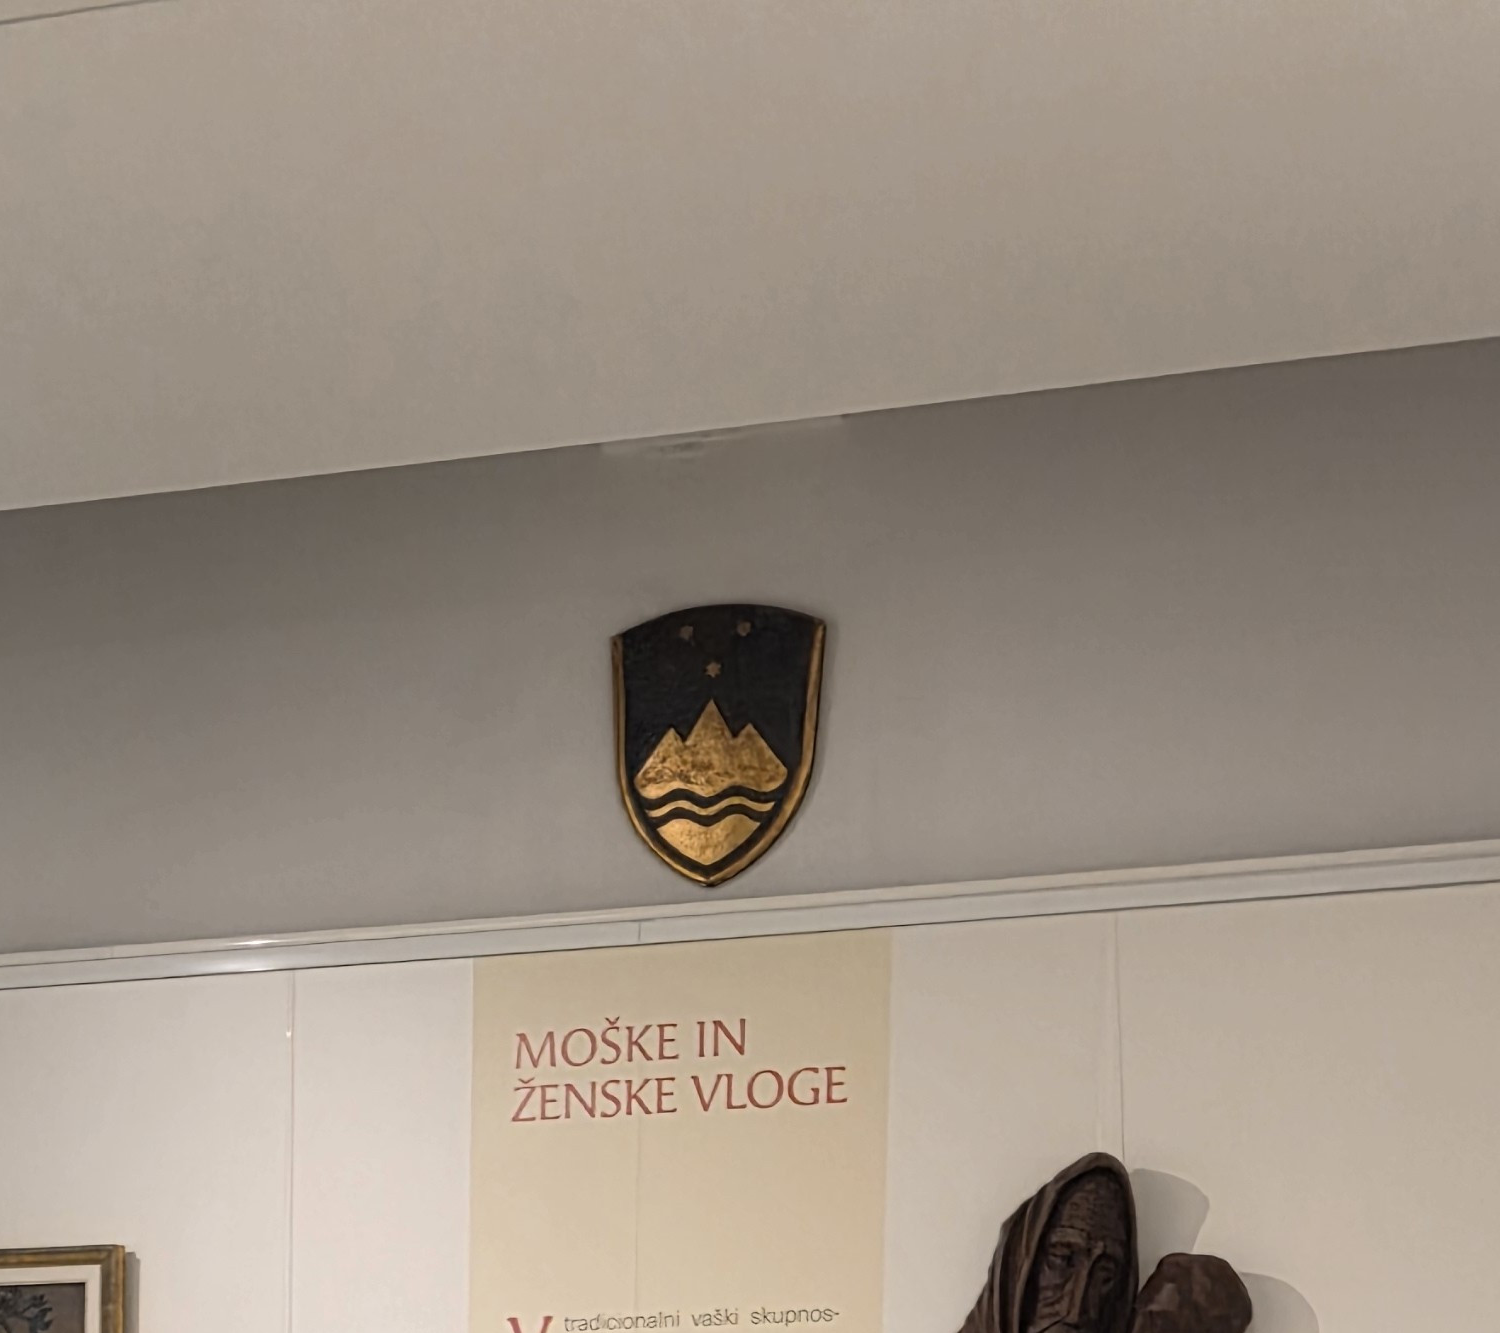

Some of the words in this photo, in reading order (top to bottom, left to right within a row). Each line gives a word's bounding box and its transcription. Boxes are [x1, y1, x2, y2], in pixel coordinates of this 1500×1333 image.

[514, 1016, 680, 1069] MOŠKE
[696, 1018, 747, 1058] IN
[510, 1077, 678, 1122] ŽENSKE
[691, 1066, 848, 1112] VLOGE
[564, 1310, 680, 1331] tradicionalni
[691, 1308, 739, 1327] vaški
[750, 1307, 840, 1327] skupnos-
